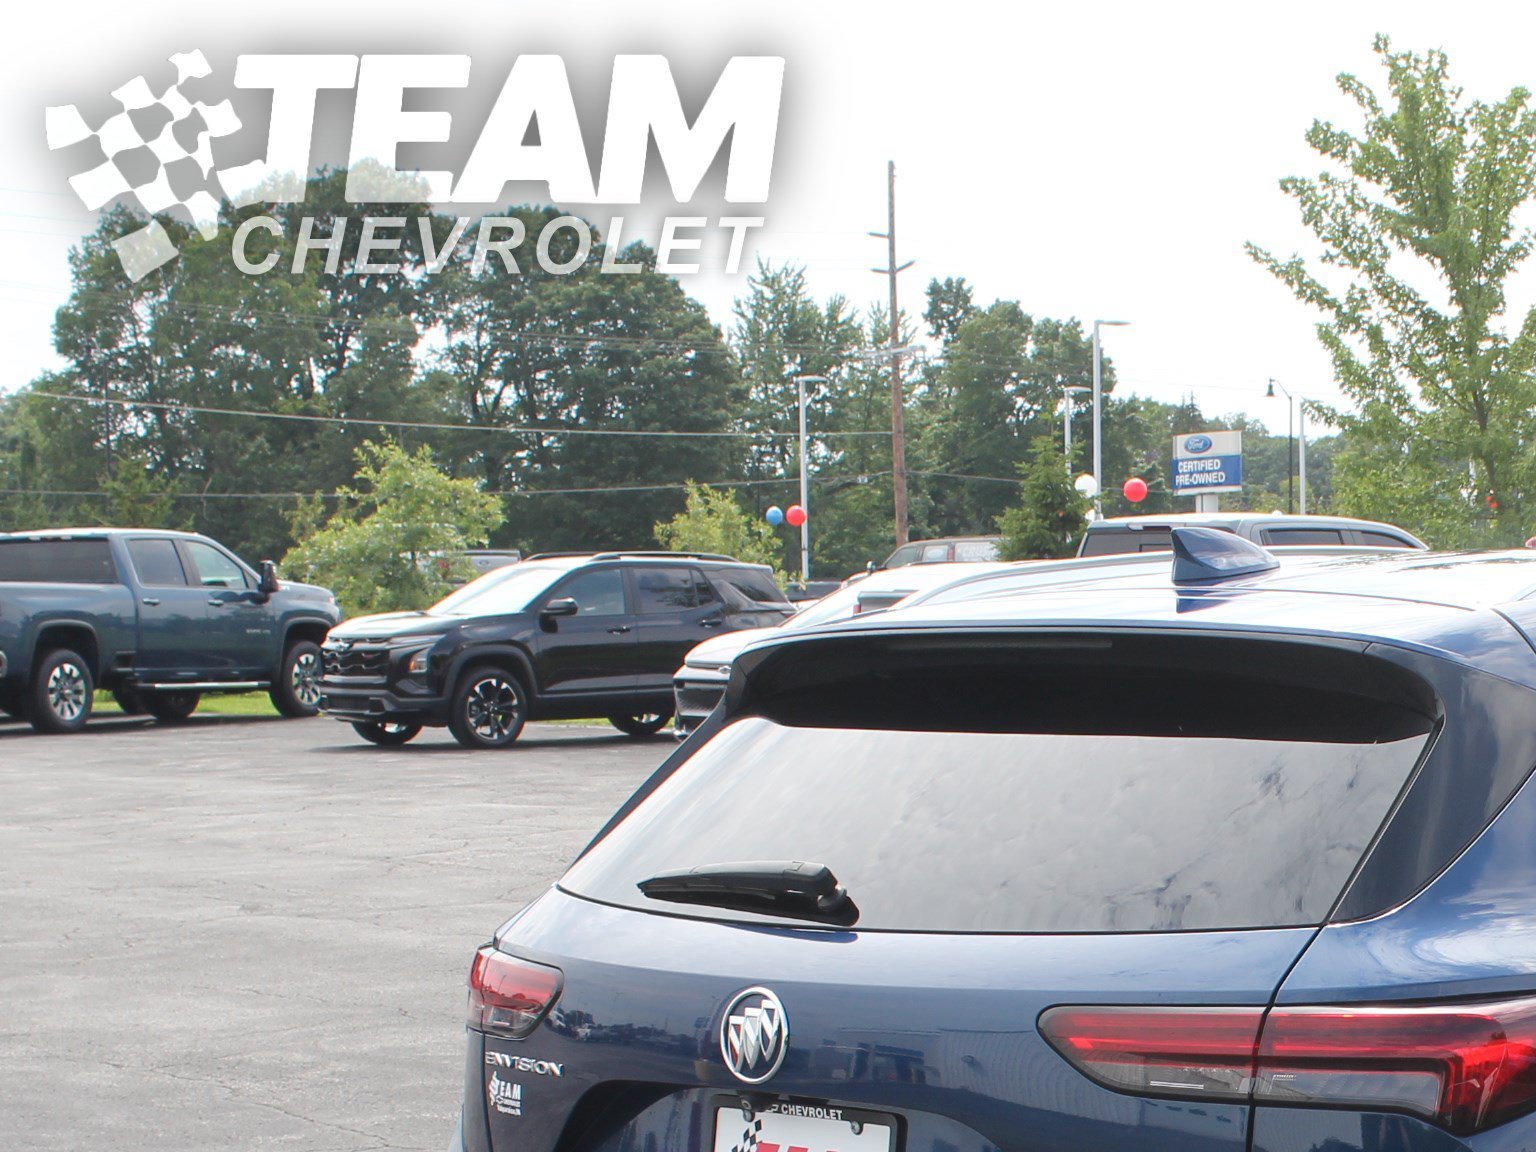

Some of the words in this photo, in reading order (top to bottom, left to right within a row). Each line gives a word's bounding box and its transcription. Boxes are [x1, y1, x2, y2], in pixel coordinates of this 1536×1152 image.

[1177, 458, 1221, 473] CERTIFIED
[1175, 471, 1226, 486] PRE-OWNED
[485, 1051, 564, 1077] ENVISION
[493, 1079, 521, 1100] TEAM
[780, 1103, 843, 1121] CHEVROLET
